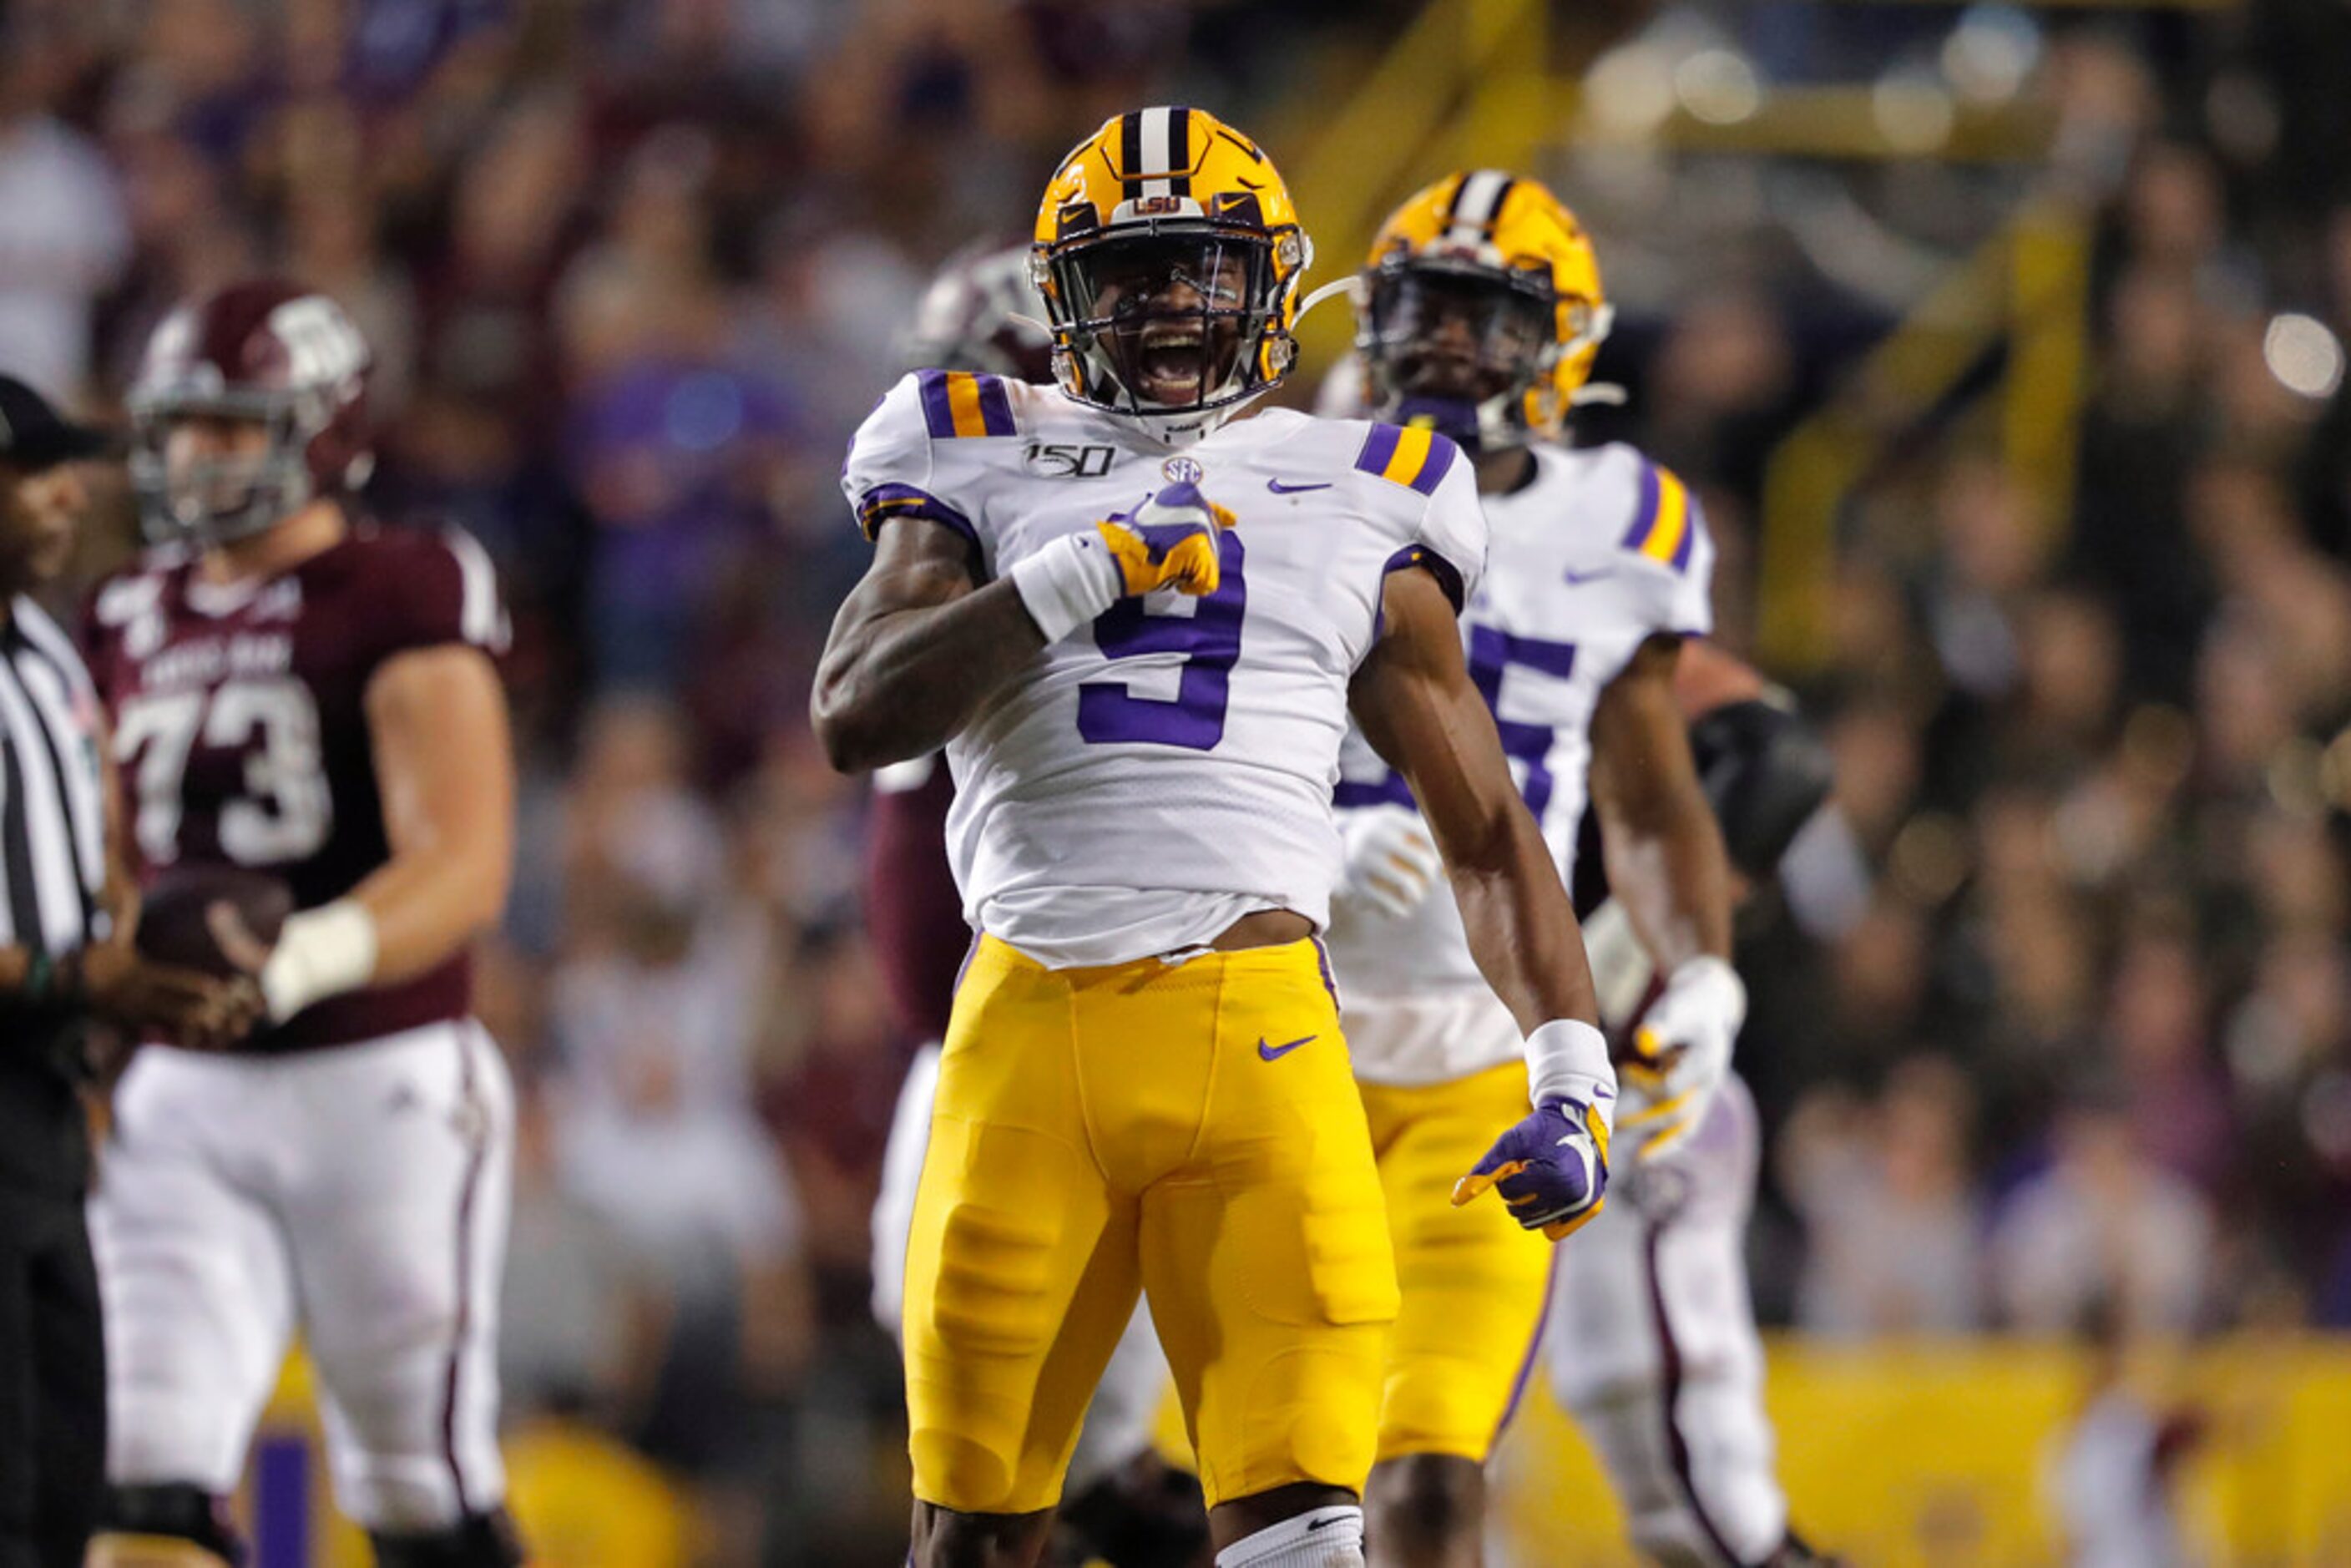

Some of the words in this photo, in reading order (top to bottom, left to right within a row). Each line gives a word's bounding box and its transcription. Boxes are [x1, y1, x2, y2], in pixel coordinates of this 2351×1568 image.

[1134, 196, 1181, 215] LSU
[1026, 444, 1115, 477] 150
[1077, 530, 1246, 751] 9
[112, 678, 332, 866] 73
